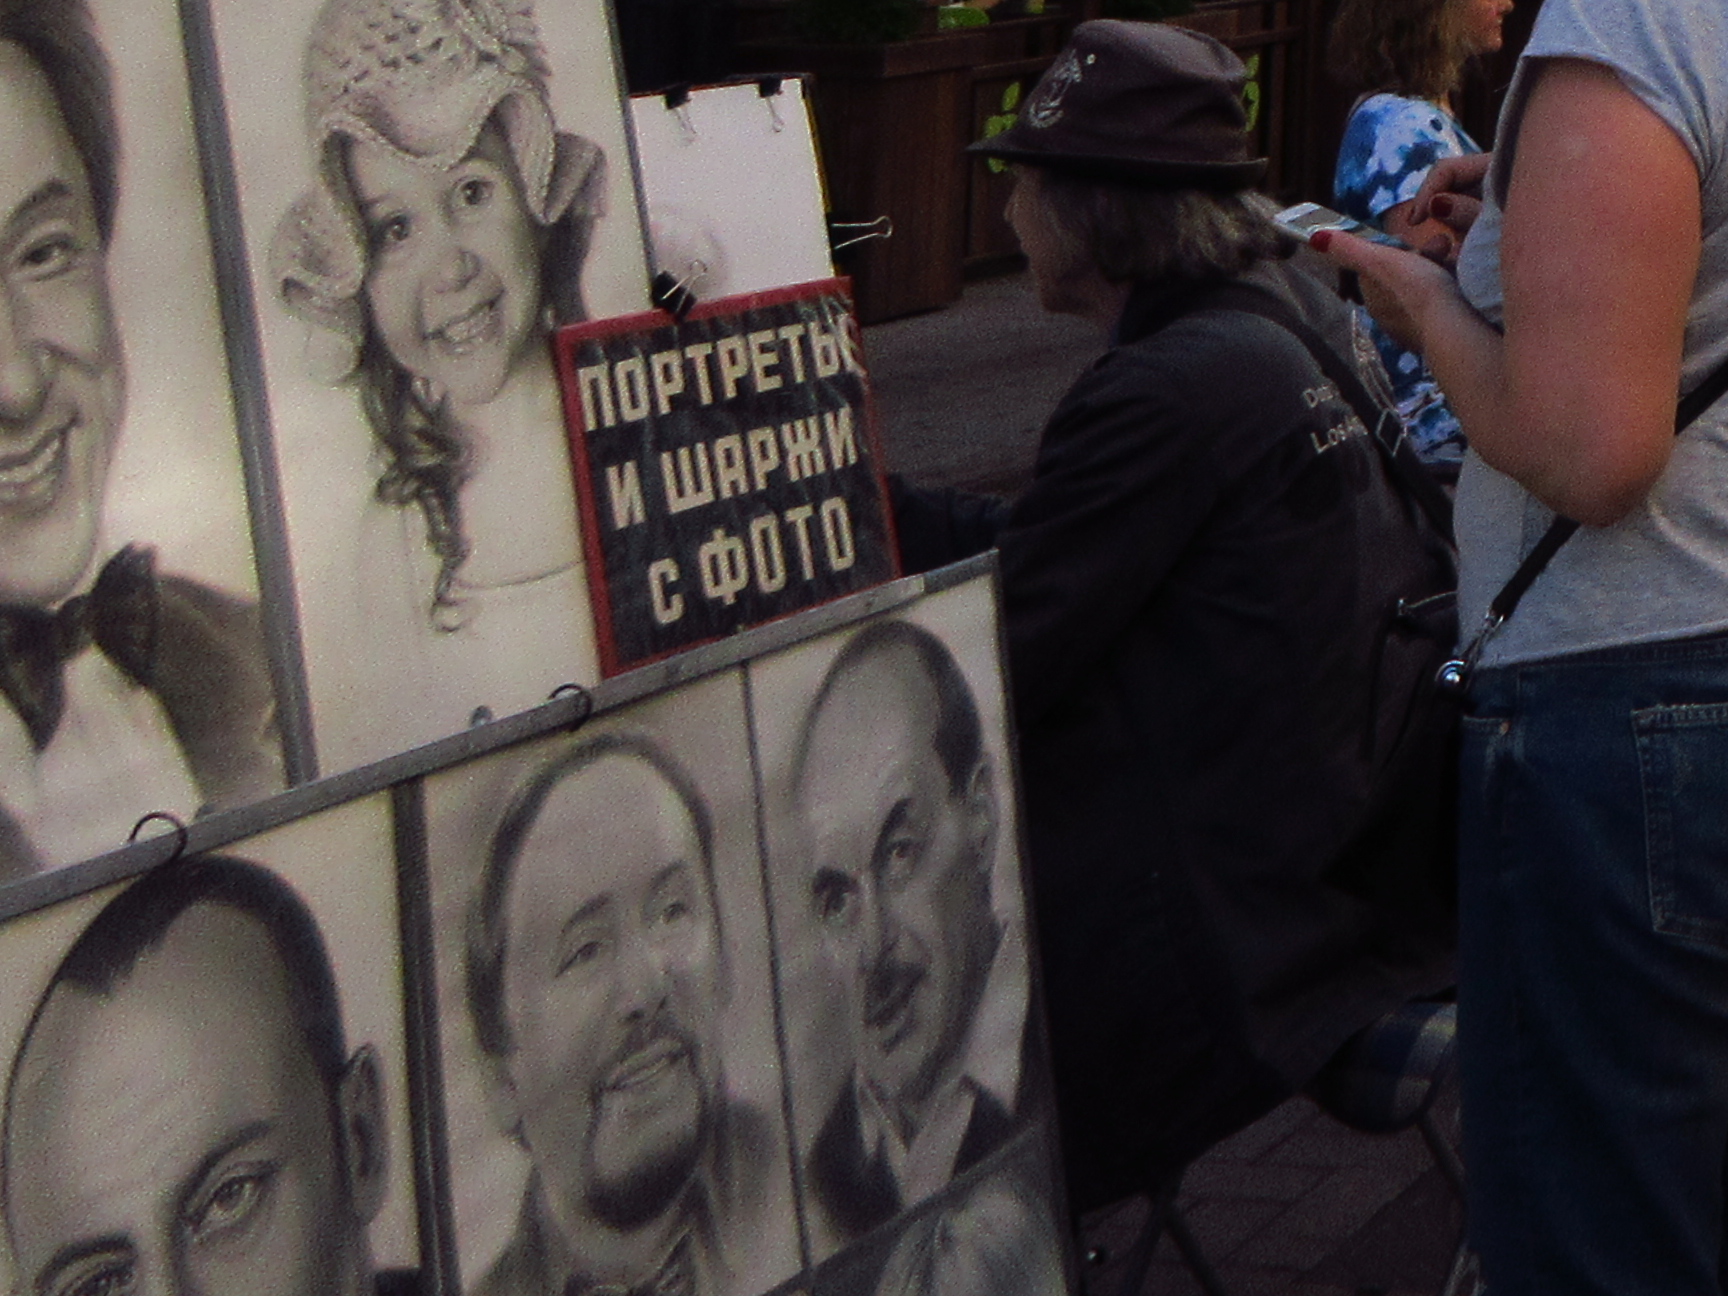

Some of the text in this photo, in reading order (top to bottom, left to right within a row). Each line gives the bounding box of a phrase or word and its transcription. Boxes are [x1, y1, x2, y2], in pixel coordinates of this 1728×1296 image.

[577, 312, 867, 433] ПОРТРЕТЫ
[606, 407, 860, 532] И ШАРЖИ
[647, 496, 857, 626] С ФОТО
